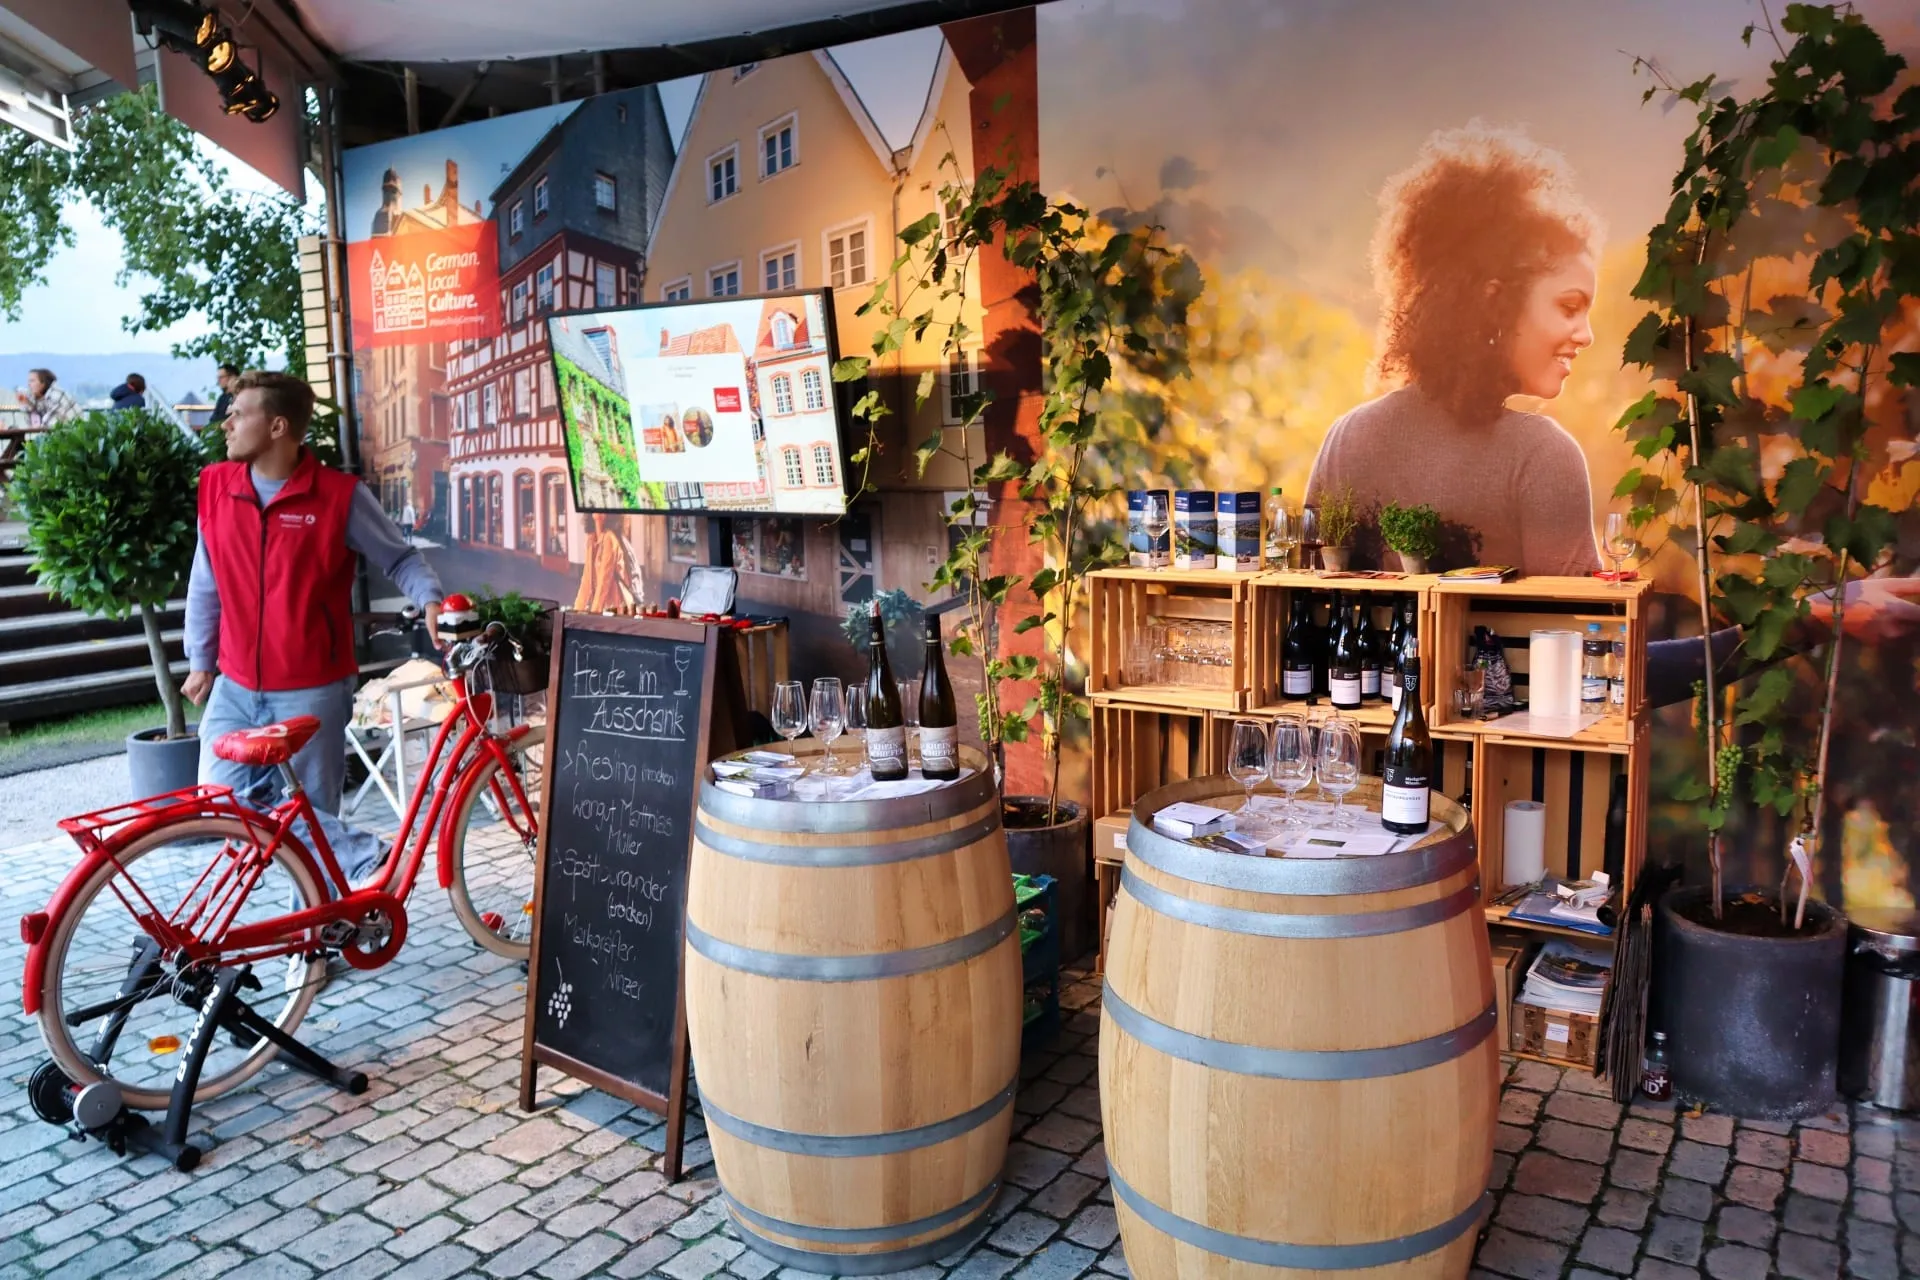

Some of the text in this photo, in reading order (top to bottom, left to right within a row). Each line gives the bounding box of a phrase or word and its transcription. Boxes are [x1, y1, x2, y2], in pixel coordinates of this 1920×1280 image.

[425, 251, 480, 273] German.
[427, 268, 461, 292] Local.
[428, 291, 478, 313] Culture.
[572, 649, 657, 697] Heute im
[590, 699, 686, 736] Ausschank
[607, 825, 643, 856] Müller
